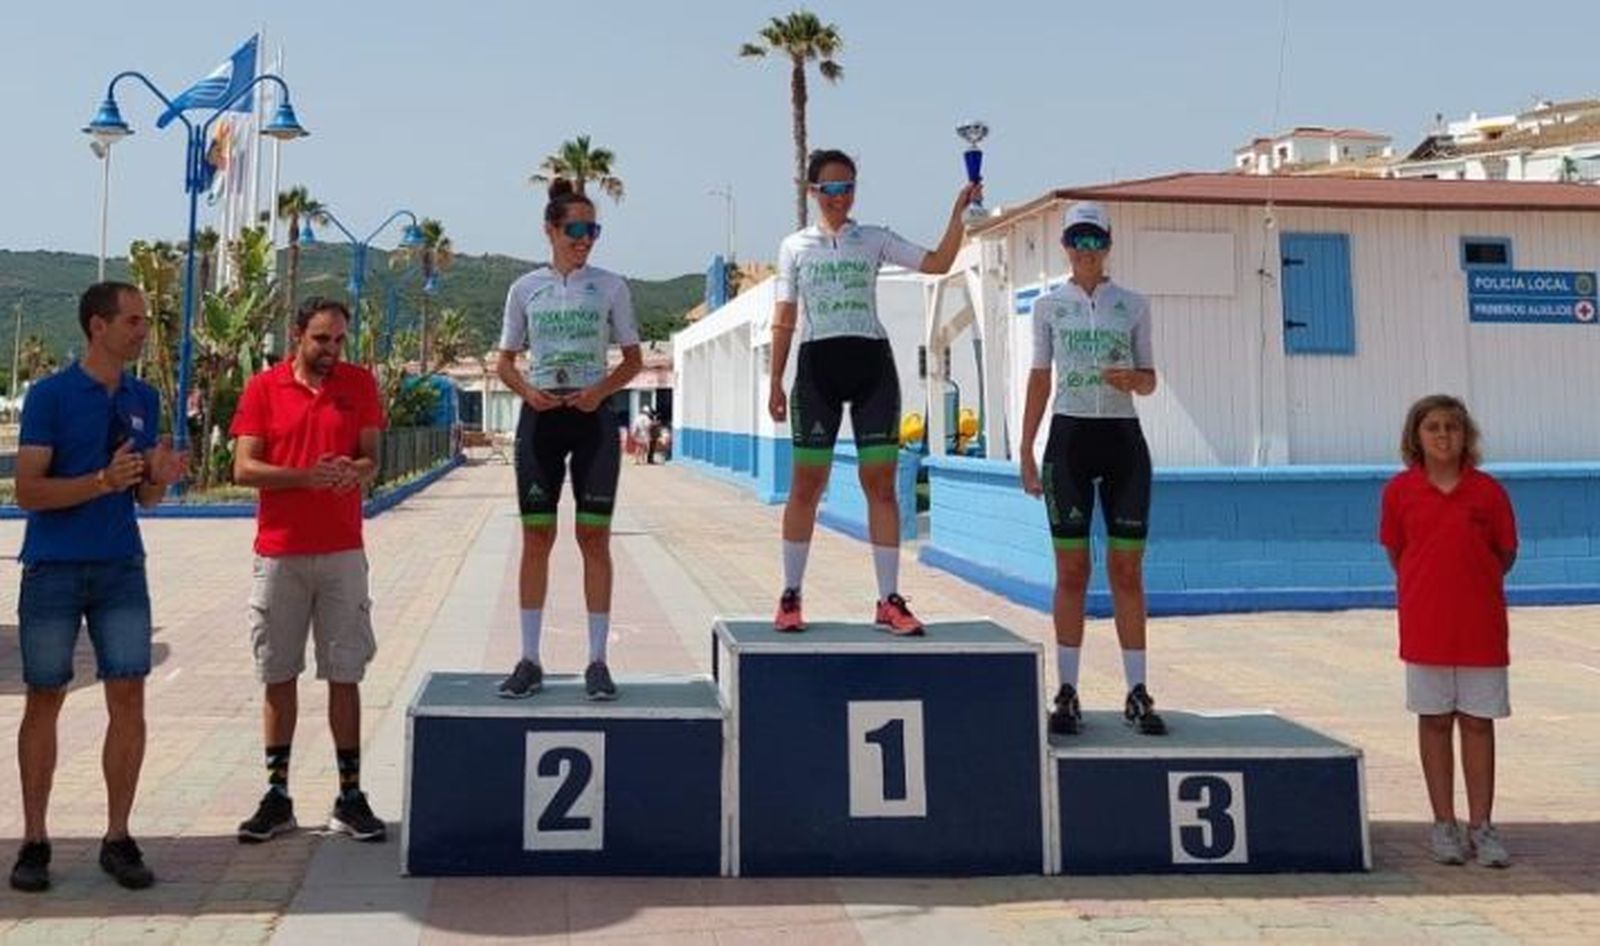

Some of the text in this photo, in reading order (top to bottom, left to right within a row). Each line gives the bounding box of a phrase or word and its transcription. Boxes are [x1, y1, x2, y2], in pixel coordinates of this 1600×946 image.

[1528, 277, 1571, 291] LOCAL
[537, 746, 593, 832] 2
[864, 718, 907, 801] 1
[1178, 776, 1236, 860] 3
